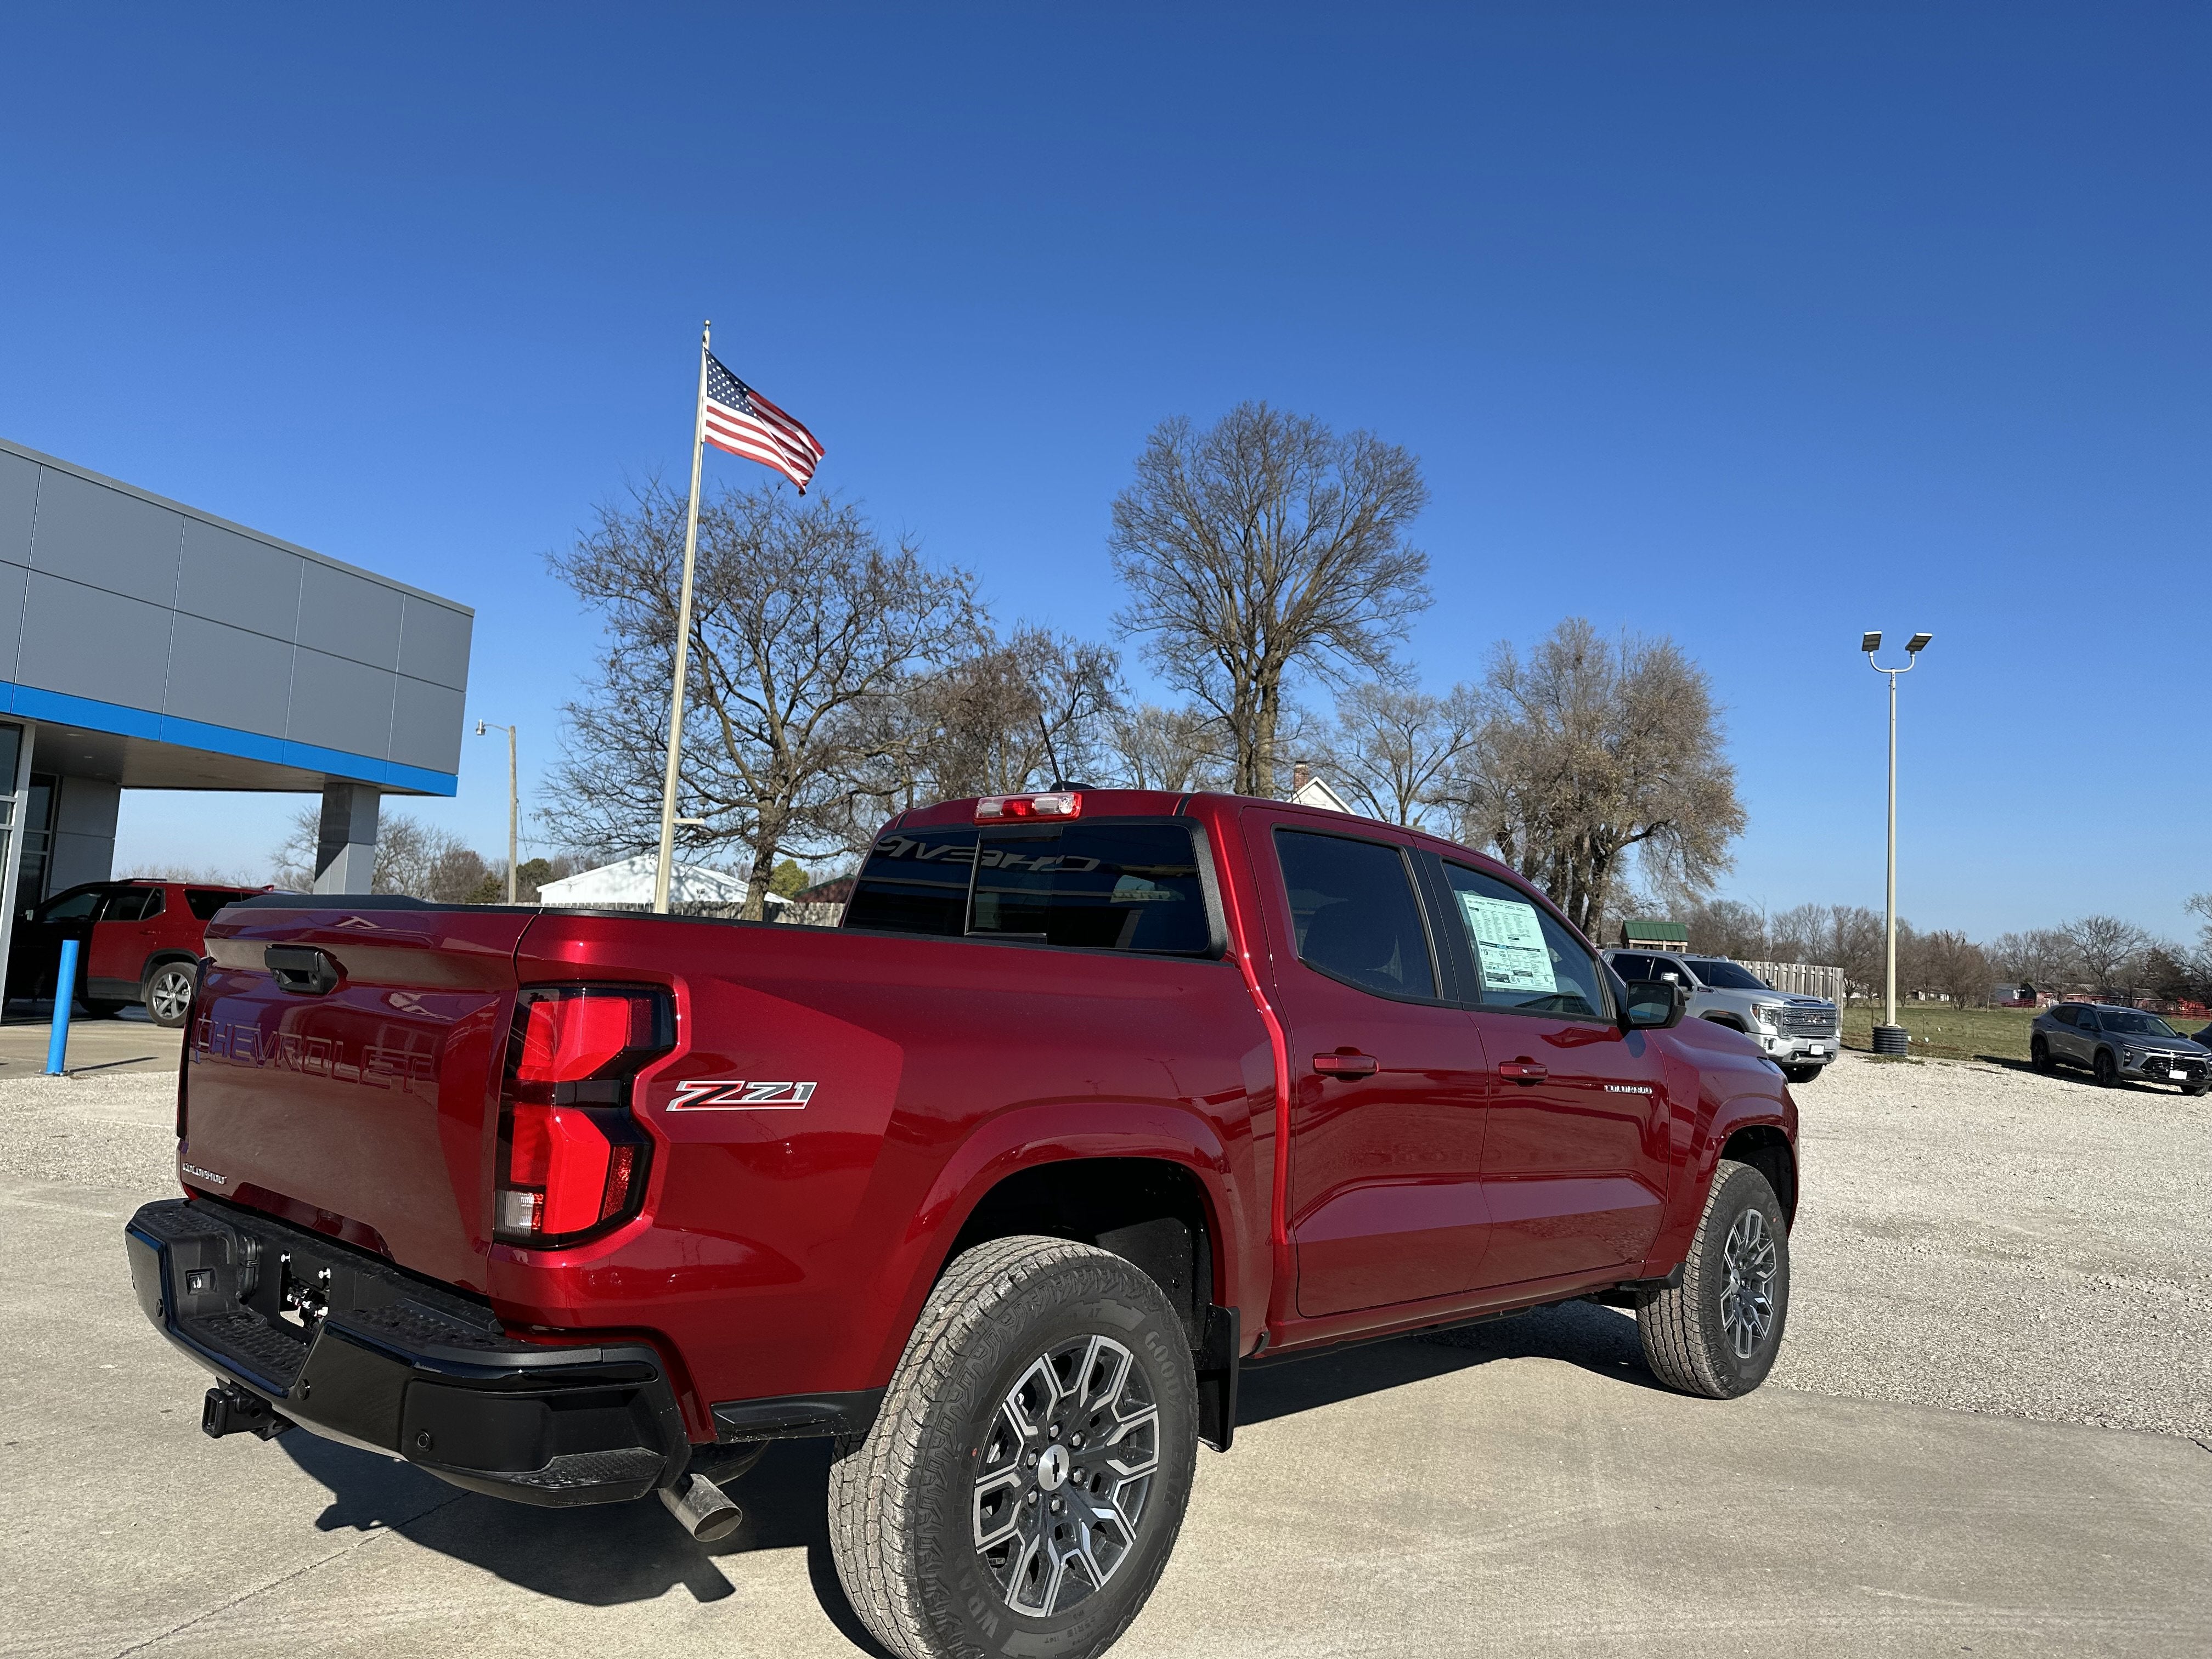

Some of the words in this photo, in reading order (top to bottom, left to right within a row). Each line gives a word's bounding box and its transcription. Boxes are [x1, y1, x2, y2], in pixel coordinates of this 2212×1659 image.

[195, 1018, 432, 1093] CHEVROLET
[665, 1080, 818, 1112] Z71
[1144, 1330, 1186, 1508] GOODYEAR
